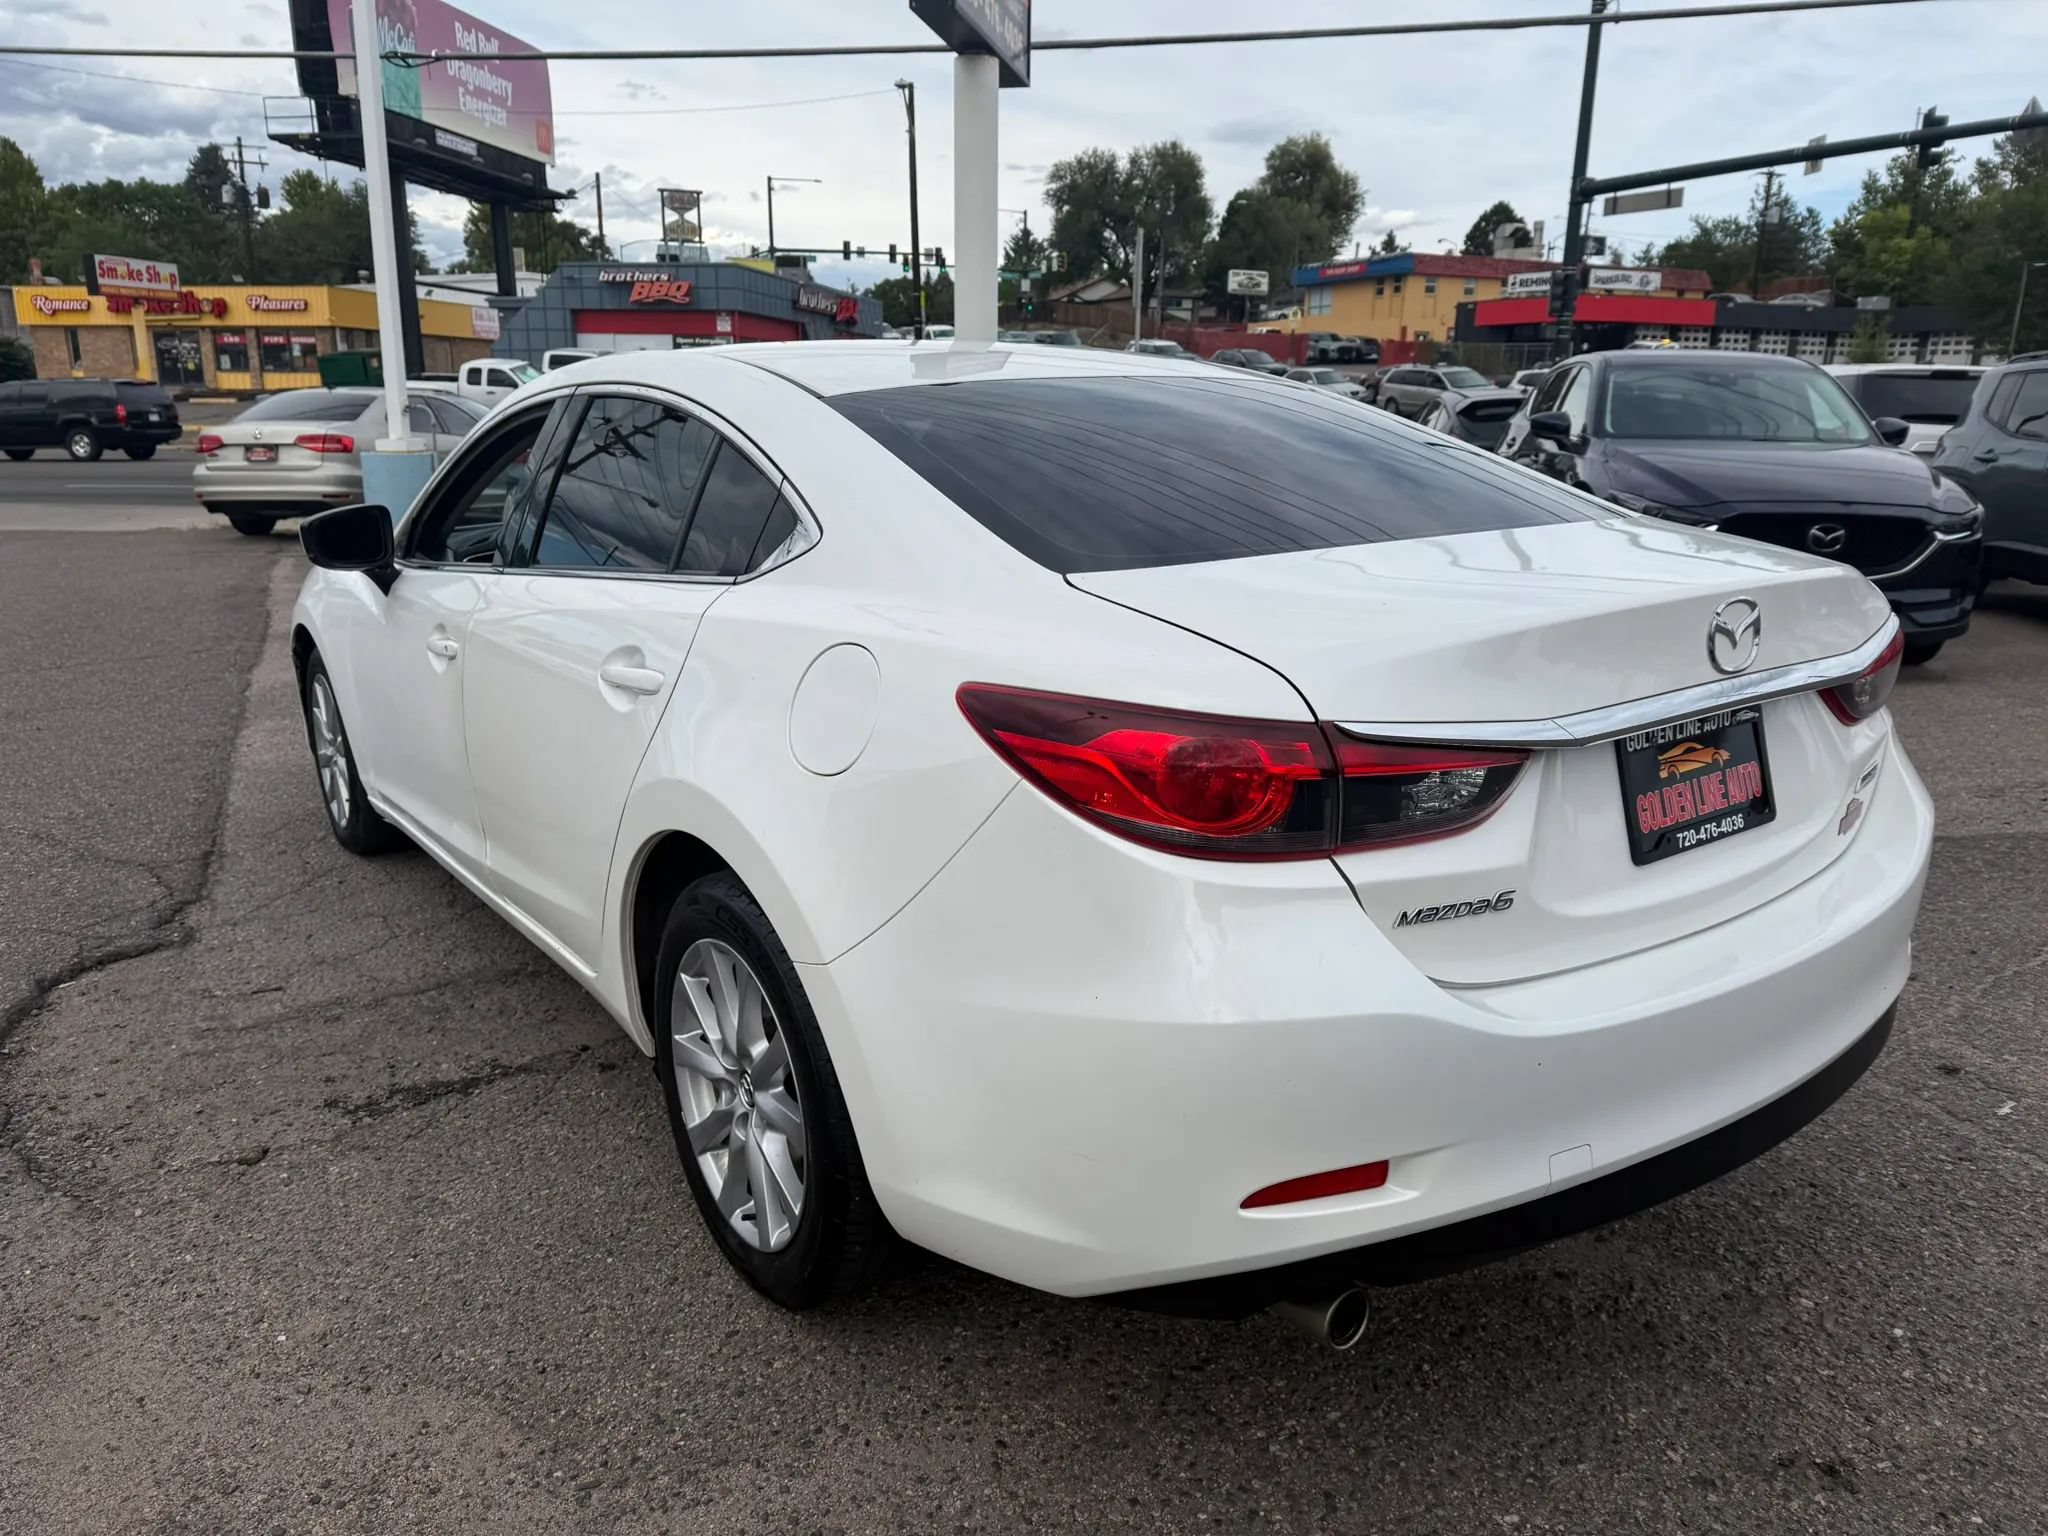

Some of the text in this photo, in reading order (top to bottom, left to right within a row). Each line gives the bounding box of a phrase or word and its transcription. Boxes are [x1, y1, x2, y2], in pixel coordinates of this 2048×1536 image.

[454, 20, 499, 64] Red Bull
[445, 49, 512, 106] Dragonberry
[458, 86, 507, 128] Energizer
[97, 259, 178, 290] Smoke Shop
[599, 270, 671, 283] brothers
[31, 293, 90, 315] Romance
[246, 295, 308, 312] Pleasures
[629, 281, 692, 304] BBQ
[1676, 718, 1702, 740] LINE
[1703, 711, 1732, 732] AUTO
[1637, 761, 1763, 834] GOLDEN LINE AUTO
[1677, 813, 1745, 849] 720-476-4036
